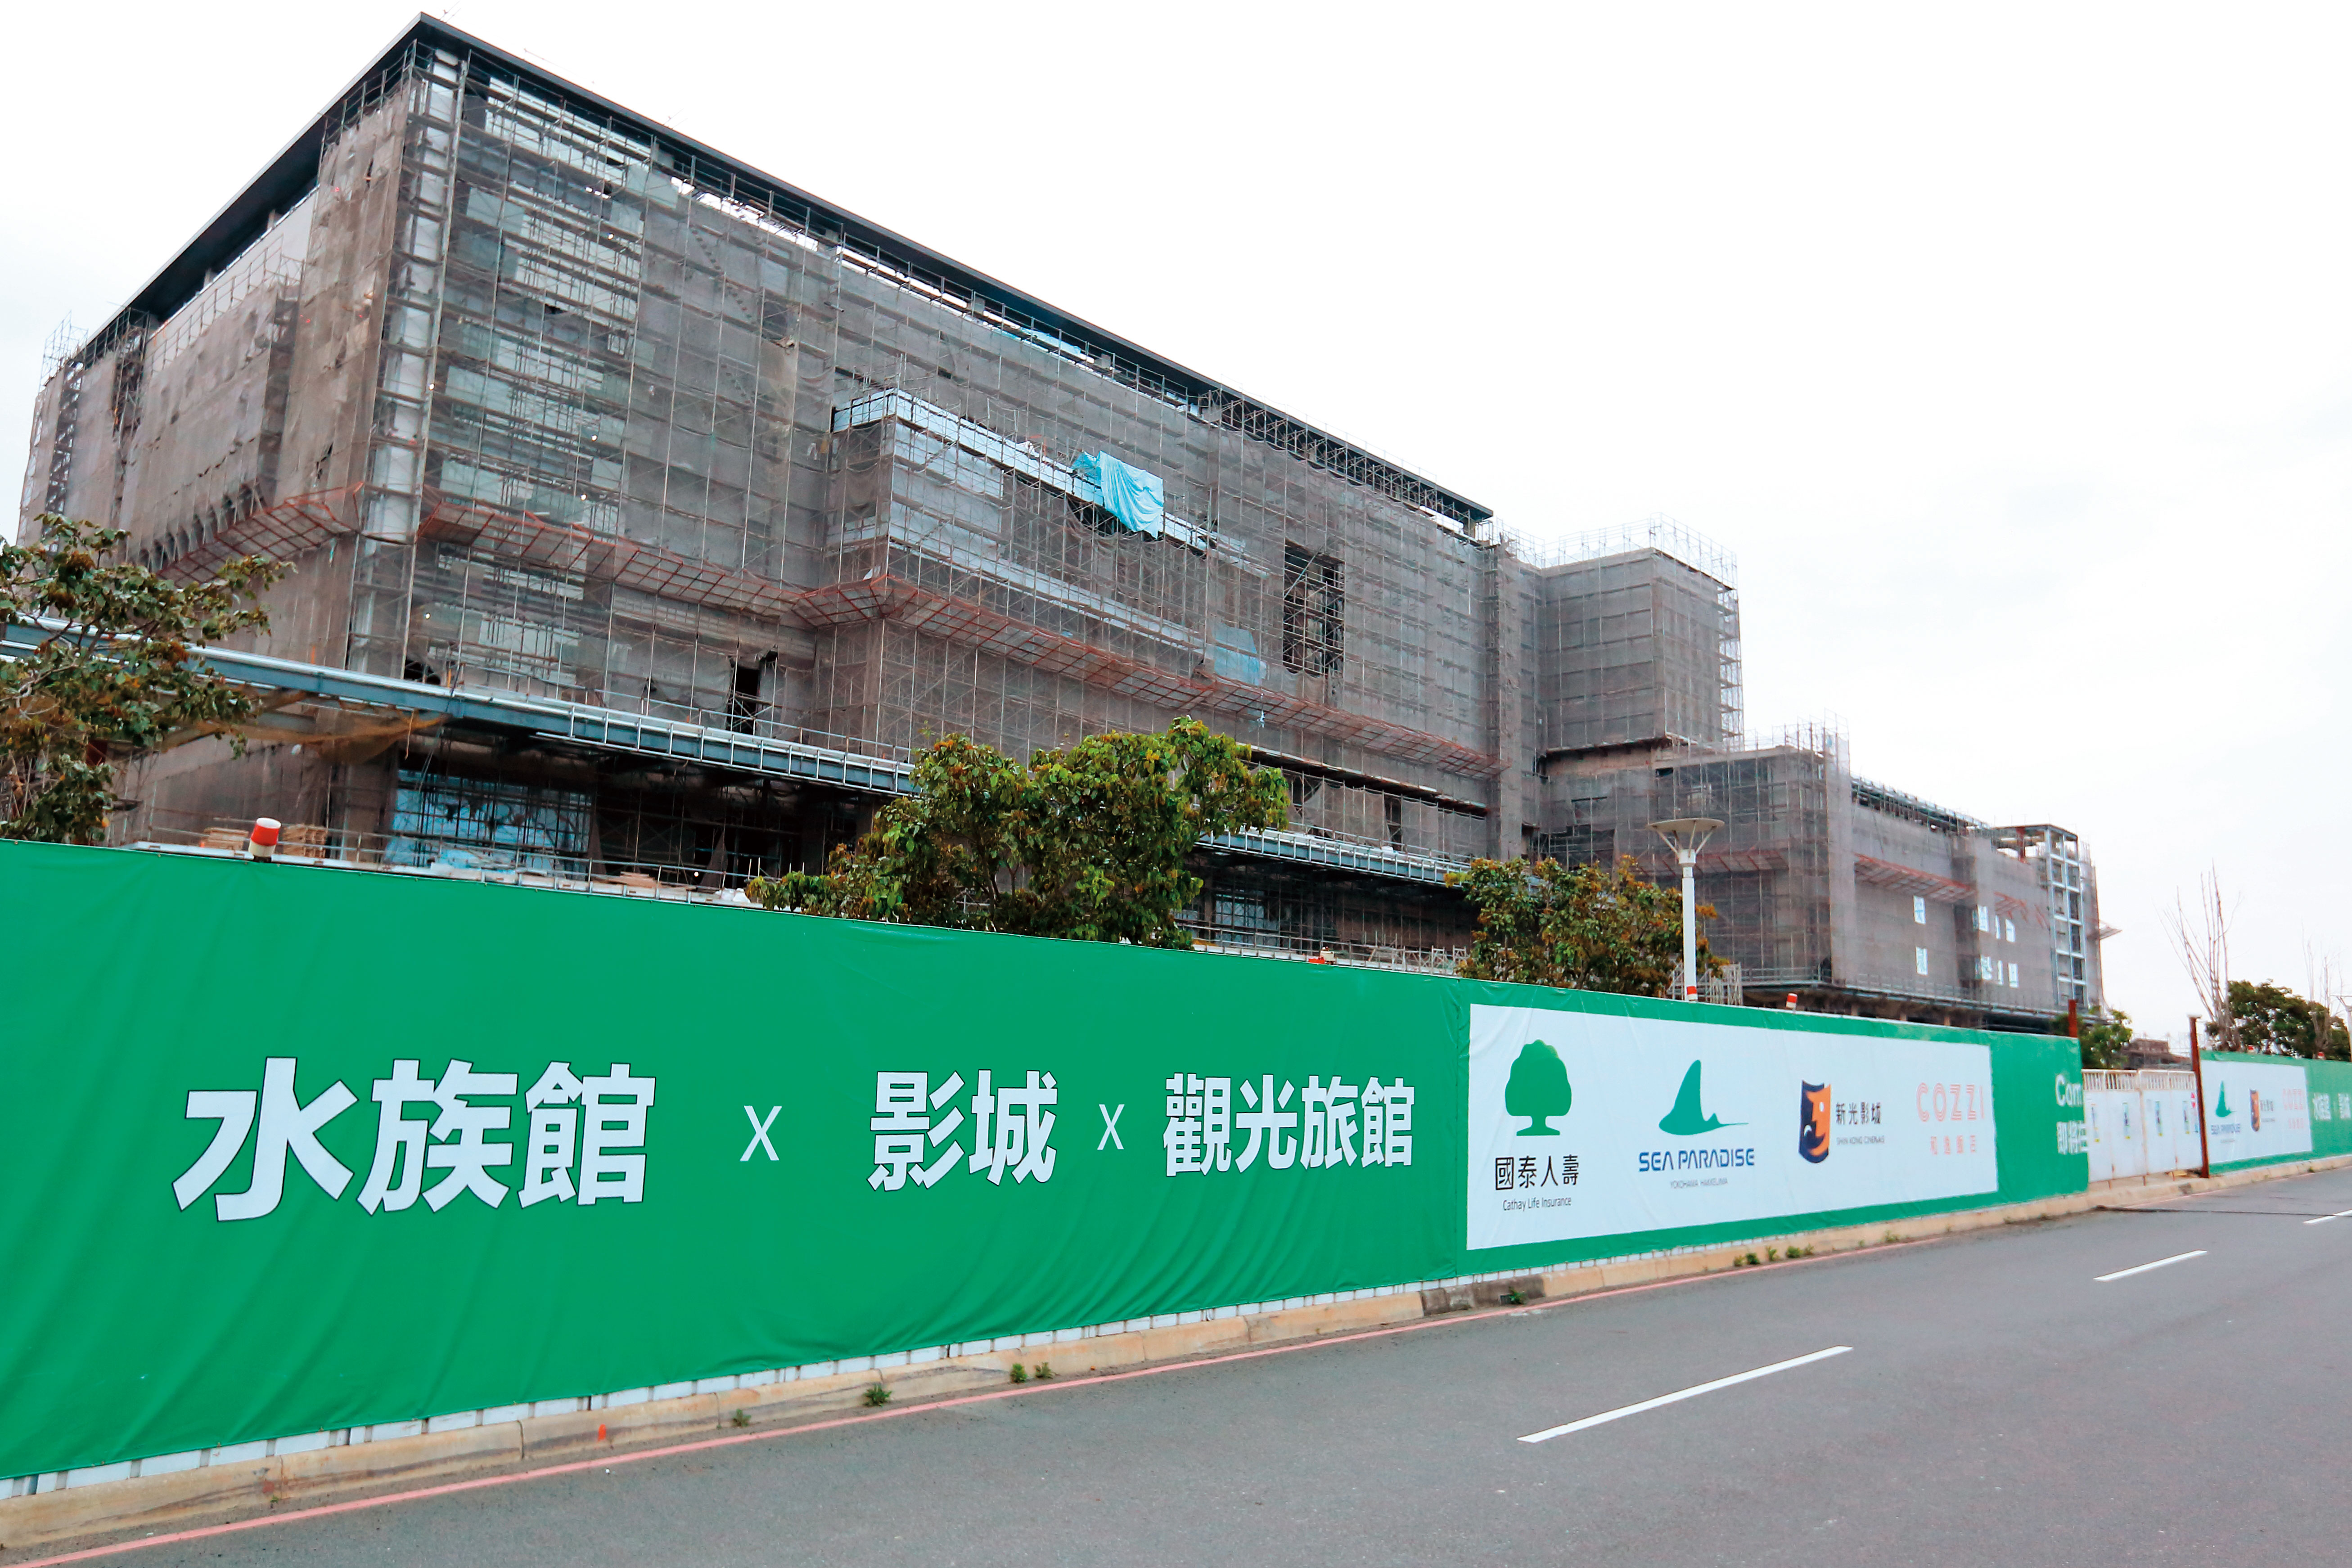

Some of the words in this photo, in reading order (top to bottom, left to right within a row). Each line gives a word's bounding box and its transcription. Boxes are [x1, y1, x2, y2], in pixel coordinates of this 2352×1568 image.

[1835, 1101, 1881, 1125] 新光影城
[1916, 1082, 1985, 1122] COZZI
[173, 1057, 656, 1221] 水族館
[867, 1070, 1058, 1191] 影城
[1163, 1073, 1415, 1176] 觀光旅館
[1495, 1154, 1579, 1191] 國泰人壽
[1639, 1151, 1674, 1172] SEA
[1677, 1148, 1755, 1170] PARADISE
[1502, 1199, 1526, 1212] Cathay
[1527, 1197, 1540, 1209] Life
[1541, 1197, 1572, 1208] Insurance
